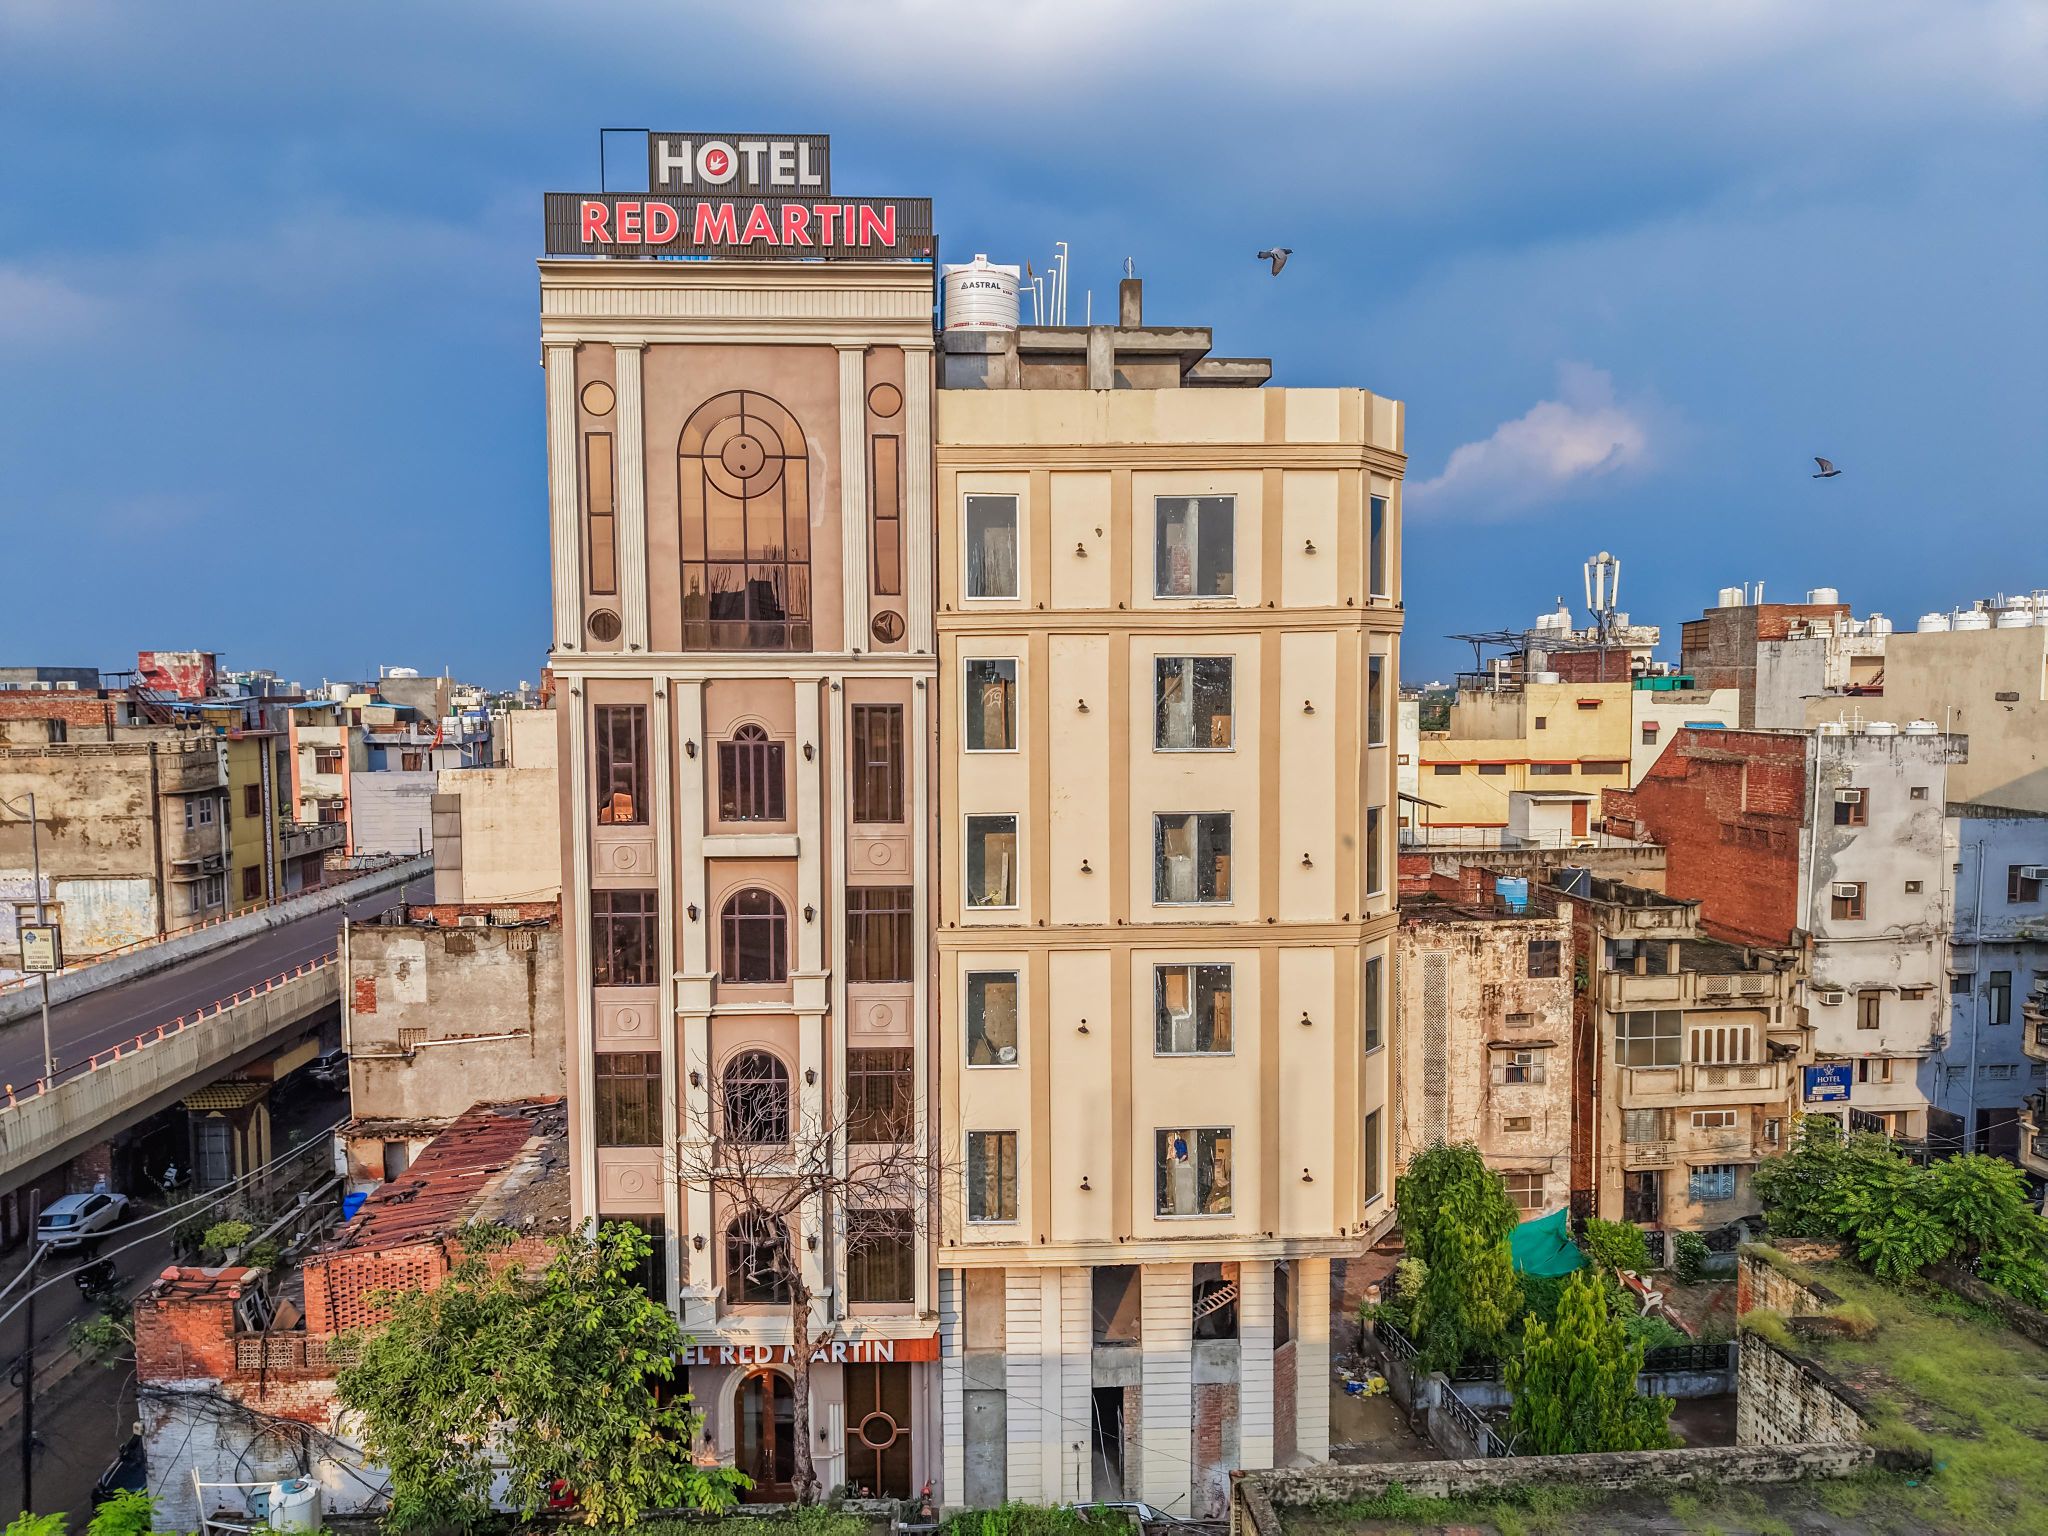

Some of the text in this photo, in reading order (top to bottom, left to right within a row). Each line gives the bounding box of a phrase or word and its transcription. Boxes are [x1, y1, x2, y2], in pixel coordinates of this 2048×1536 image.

[658, 140, 822, 185] HOTEL
[580, 200, 897, 247] RED MARTIN
[969, 281, 1001, 289] ASTRAL
